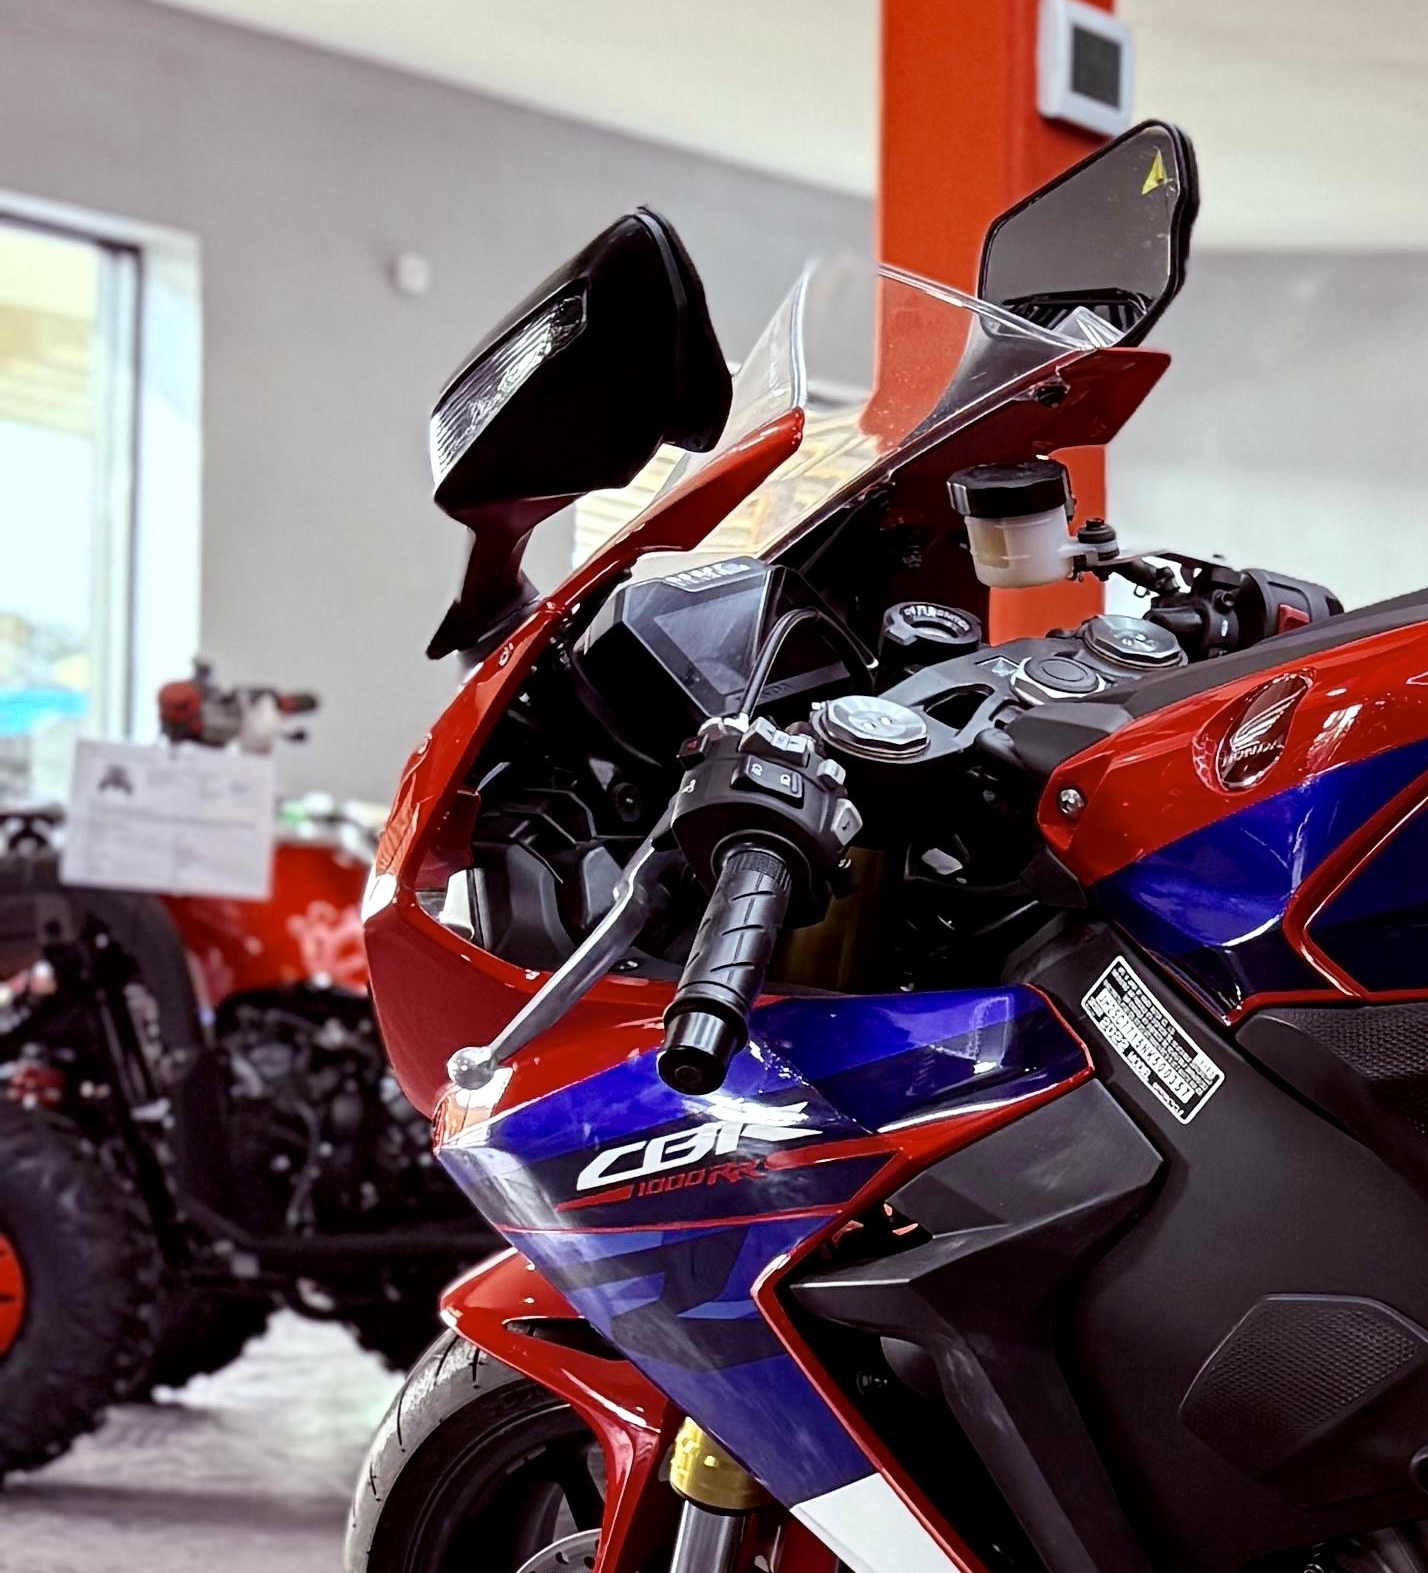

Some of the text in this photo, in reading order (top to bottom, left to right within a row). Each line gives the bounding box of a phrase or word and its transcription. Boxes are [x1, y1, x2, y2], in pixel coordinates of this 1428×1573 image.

[1098, 1015, 1153, 1082] 2022 MODEL
[576, 1100, 823, 1191] CBR
